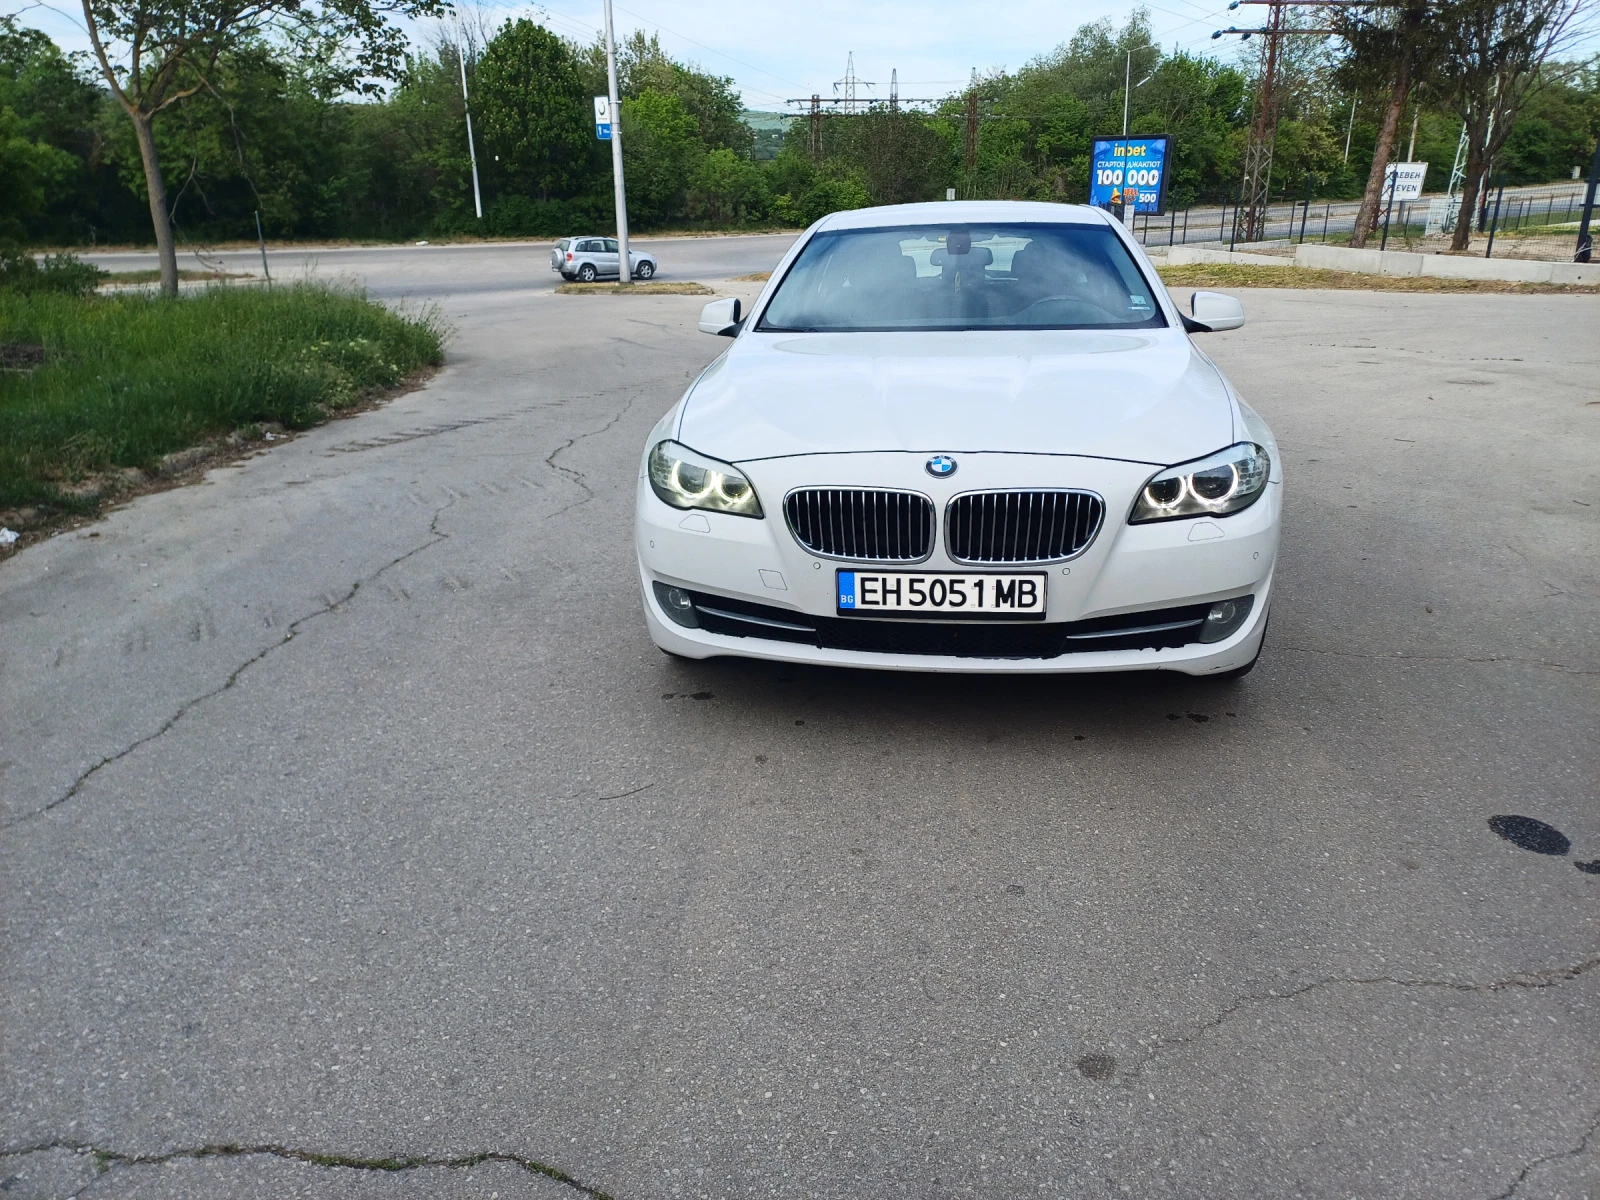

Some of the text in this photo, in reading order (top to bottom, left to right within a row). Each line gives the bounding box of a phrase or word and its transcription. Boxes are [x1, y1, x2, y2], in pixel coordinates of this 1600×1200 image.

[1126, 160, 1161, 168] ДЖАКПОТ
[1387, 184, 1417, 192] PEVEN
[1139, 193, 1157, 203] 500
[840, 595, 854, 604] BG
